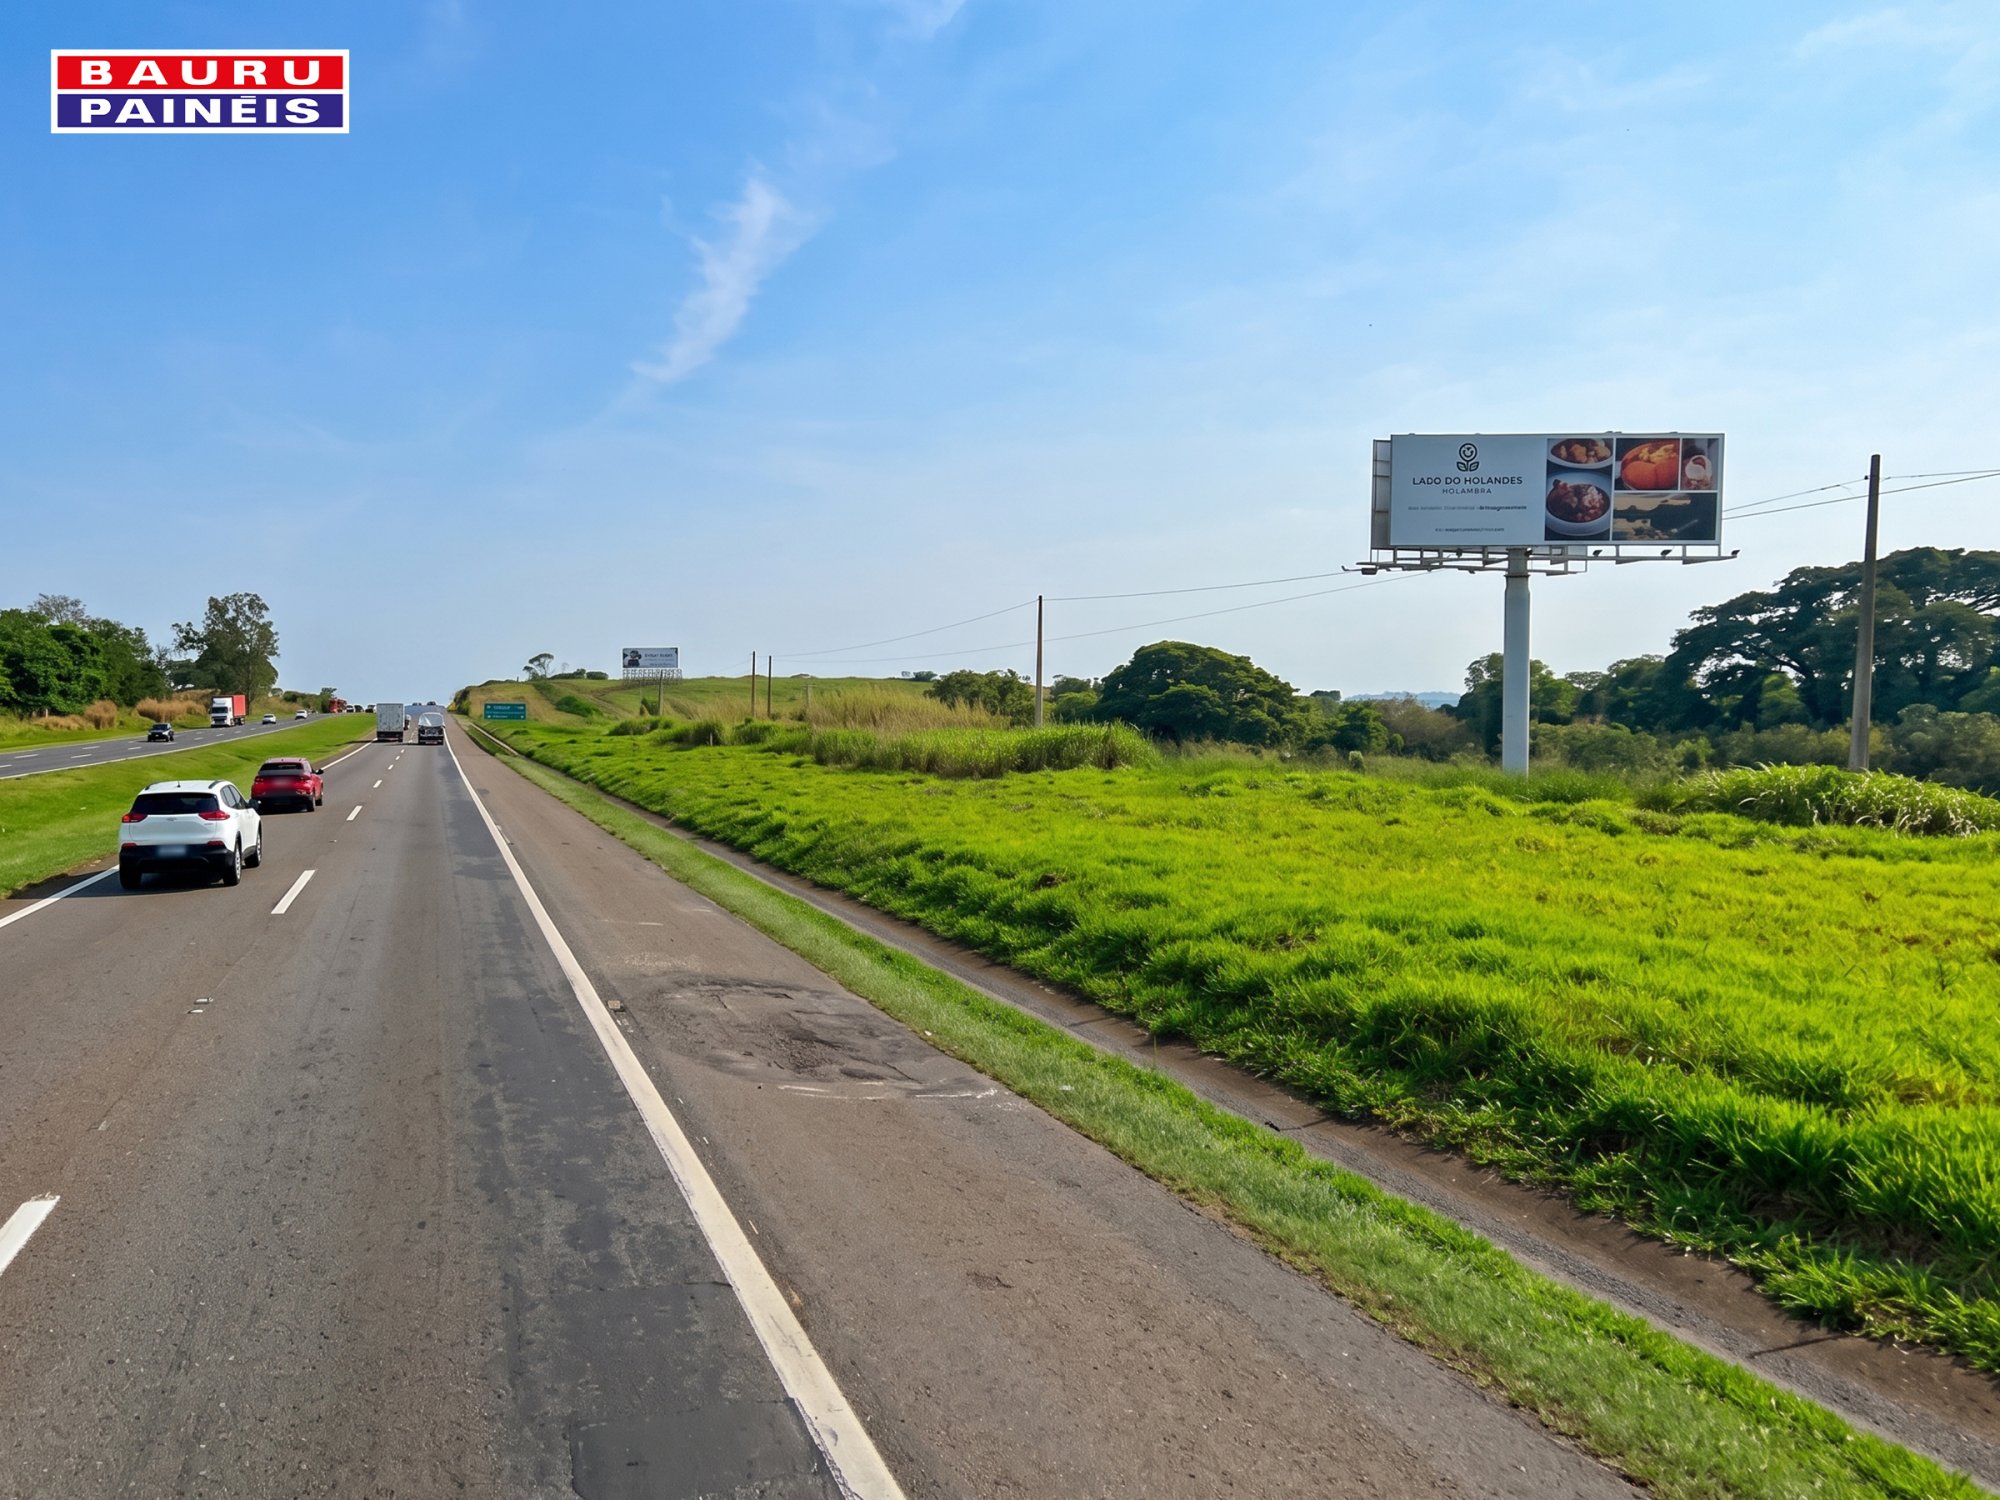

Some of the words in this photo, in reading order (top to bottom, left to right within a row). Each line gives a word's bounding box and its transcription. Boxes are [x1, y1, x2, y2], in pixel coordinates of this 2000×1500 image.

[1412, 477, 1442, 486] LADO
[1445, 476, 1461, 485] DO
[1464, 476, 1523, 485] HOLANDES
